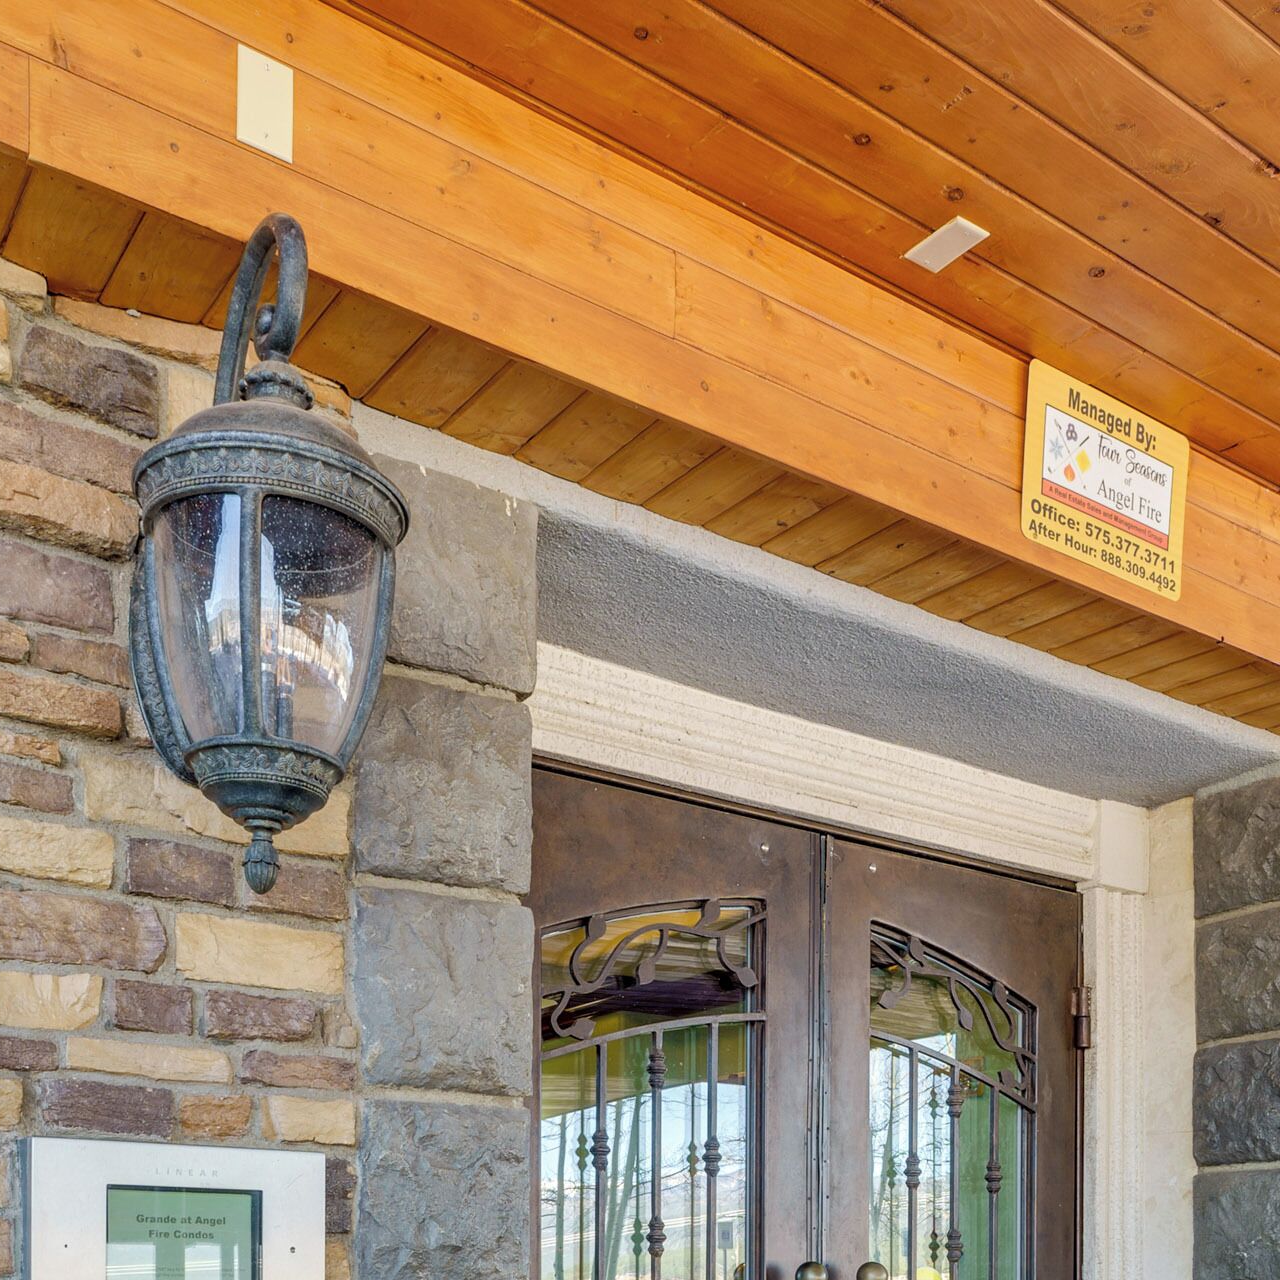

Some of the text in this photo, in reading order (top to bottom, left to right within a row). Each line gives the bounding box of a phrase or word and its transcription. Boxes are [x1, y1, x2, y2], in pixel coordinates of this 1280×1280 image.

[1068, 387, 1156, 452] Managed By:
[1098, 433, 1167, 486] Four Seasons
[1097, 479, 1162, 523] Angel Fire
[1124, 478, 1132, 487] of
[1028, 519, 1176, 592] After Hour: 888.309.4492
[1030, 498, 1175, 574] Office: 575.377.3711
[155, 1167, 218, 1177] LINEAR
[136, 1214, 226, 1227] Grande at Angel
[148, 1230, 214, 1239] Fire Condos
